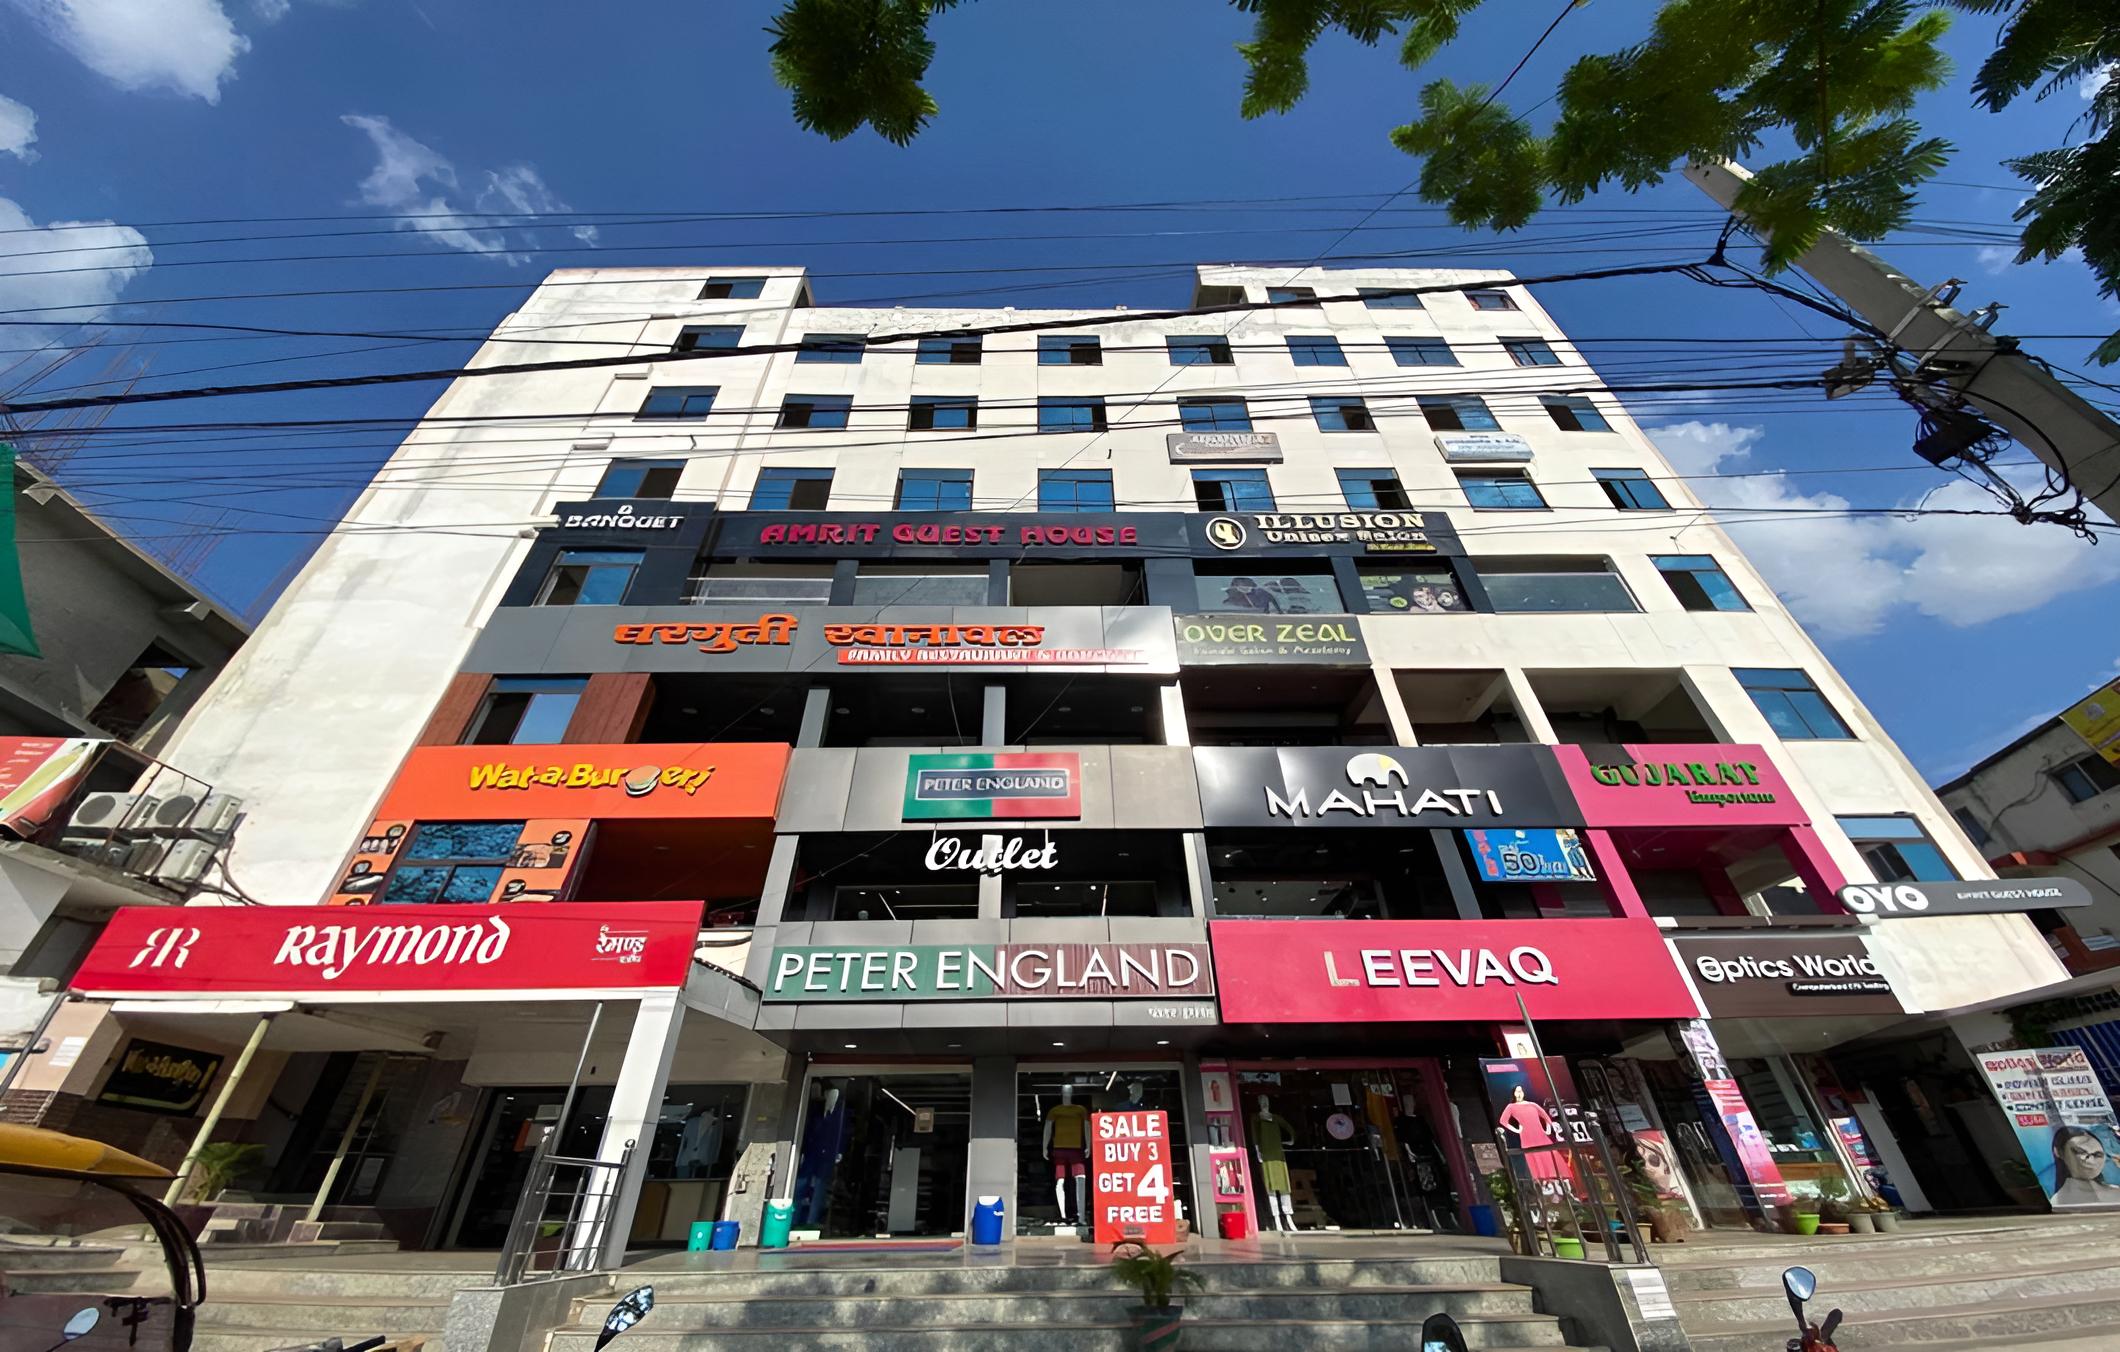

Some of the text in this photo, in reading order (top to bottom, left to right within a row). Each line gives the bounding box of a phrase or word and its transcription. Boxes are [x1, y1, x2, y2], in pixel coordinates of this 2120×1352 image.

[564, 514, 685, 529] BANQUET
[1254, 514, 1426, 530] ILLUSION
[760, 523, 1138, 546] AMRIT GUEST HOUSE
[613, 613, 799, 654] घरगुती
[1183, 624, 1357, 643] OVER ZEAL
[924, 777, 1065, 791] PETER ENGLAND
[1590, 763, 1760, 786] GUJARAT
[1265, 786, 1504, 817] MAHATI
[924, 837, 1059, 873] Outlet
[1842, 884, 1929, 913] OYO
[273, 915, 511, 980] Raymond
[774, 948, 1199, 992] PETER ENGLAND
[1323, 946, 1559, 987] LEEVAQ
[1100, 1114, 1162, 1138] SALE
[1105, 1142, 1159, 1162] BUY 3
[1099, 1164, 1169, 1204] GET 4
[1107, 1206, 1164, 1223] FREE
